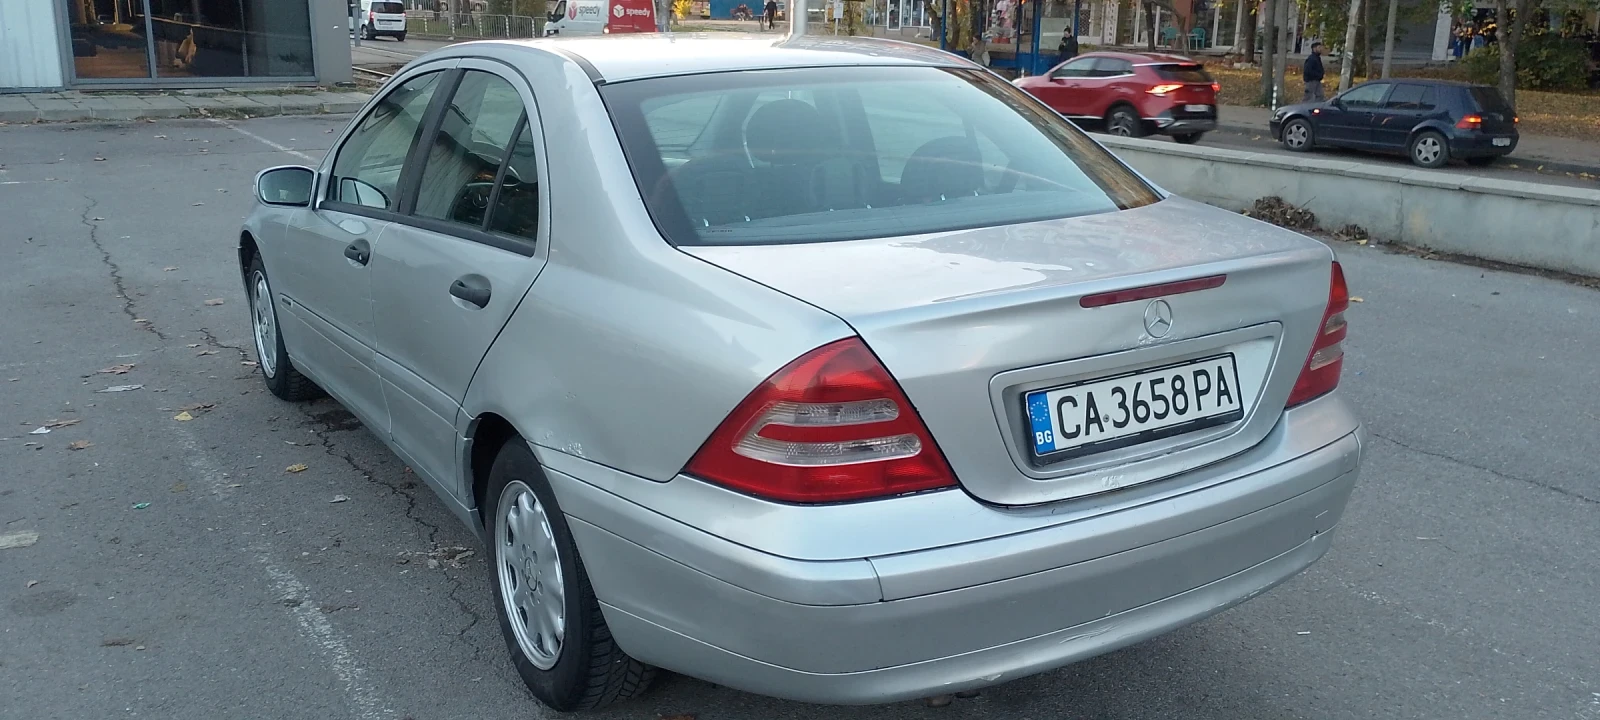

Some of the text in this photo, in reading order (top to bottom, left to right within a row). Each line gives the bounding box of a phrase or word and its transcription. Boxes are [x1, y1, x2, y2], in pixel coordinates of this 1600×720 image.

[579, 5, 600, 17] speedy
[626, 8, 650, 18] speedy
[1056, 365, 1233, 439] CA 3658 PA
[1035, 430, 1053, 445] BG
